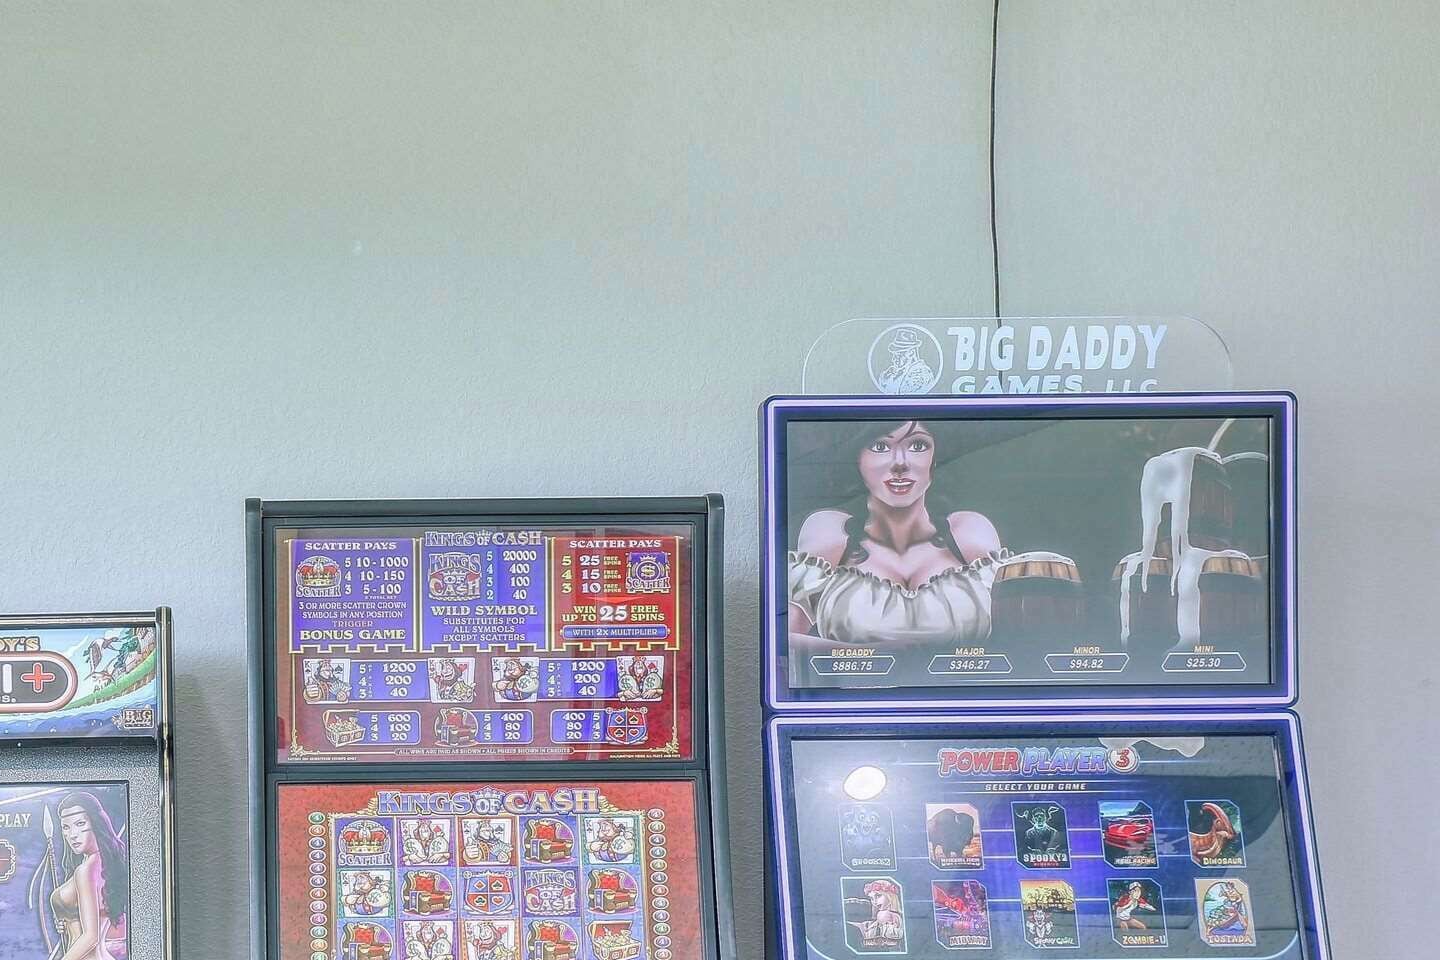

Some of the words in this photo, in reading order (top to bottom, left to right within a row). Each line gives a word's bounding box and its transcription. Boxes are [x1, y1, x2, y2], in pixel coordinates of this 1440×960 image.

[947, 324, 1015, 372] BIG
[1025, 324, 1169, 371] DADDY
[304, 542, 361, 551] SCATTER
[364, 541, 397, 550] PAYS
[569, 540, 627, 549] SCATTER
[629, 539, 662, 548] PAYS
[486, 551, 493, 562] 5
[502, 551, 537, 562] 20000
[344, 557, 352, 568] 5
[486, 564, 494, 574] 4
[509, 564, 530, 574] 400
[344, 571, 352, 581] 4
[486, 577, 493, 587] 3
[510, 577, 530, 586] 100
[486, 590, 494, 600] 2
[512, 590, 527, 600] 40
[305, 602, 318, 610] OR
[319, 602, 342, 610] MORE
[342, 602, 376, 610] SCATTER
[431, 605, 470, 616] WILD
[475, 605, 537, 616] SYMBOL
[573, 605, 596, 614] WIN
[630, 605, 659, 613] FREE
[302, 611, 338, 619] SYMBOLS
[339, 611, 348, 619] IN
[348, 611, 365, 619] ANY
[562, 613, 579, 622] UP
[581, 613, 597, 622] TO
[599, 604, 628, 622] 25
[630, 613, 665, 621] SPINS
[332, 620, 373, 628] TRIGGER
[443, 617, 505, 625] SUBSTITUTES
[506, 617, 525, 625] FOR
[453, 626, 470, 634] ALL
[472, 625, 515, 633] SYMBOLS
[572, 629, 594, 637] WITH
[610, 628, 658, 636] MULTIPLIER
[300, 630, 354, 641] BONUS
[358, 629, 406, 641] GAME
[443, 634, 477, 642] EXCEPT
[479, 633, 526, 641] SCATTERS
[831, 649, 848, 658] BIG
[848, 649, 876, 658] DADDY
[955, 647, 986, 656] MAJOR
[1073, 646, 1101, 655] MINOR
[1194, 645, 1214, 653] MINI
[359, 663, 367, 673] 5
[382, 662, 417, 673] 1200
[547, 662, 555, 672] 5
[571, 661, 605, 672] 1200
[831, 660, 873, 673] $886.75
[949, 659, 991, 672] $346.27
[1069, 658, 1104, 670] $94.82
[1185, 656, 1221, 669] $25.30
[359, 677, 367, 686] 4
[385, 675, 412, 685] 200
[547, 675, 555, 685] 4
[574, 674, 601, 684] 200
[389, 687, 408, 697] 40
[577, 686, 597, 696] 40
[387, 713, 411, 722] 600
[500, 712, 524, 722] 400
[562, 712, 586, 721] 400
[938, 748, 1020, 777] POWER
[1021, 747, 1109, 776] PLAYER
[1115, 749, 1131, 769] 3
[985, 783, 1023, 791] SELECT
[1027, 783, 1054, 791] YOUR
[1058, 783, 1086, 791] GAME
[376, 791, 474, 816] KINGS
[474, 797, 503, 815] OF
[503, 788, 601, 815] CASH
[1202, 856, 1243, 865] DINOSAUR
